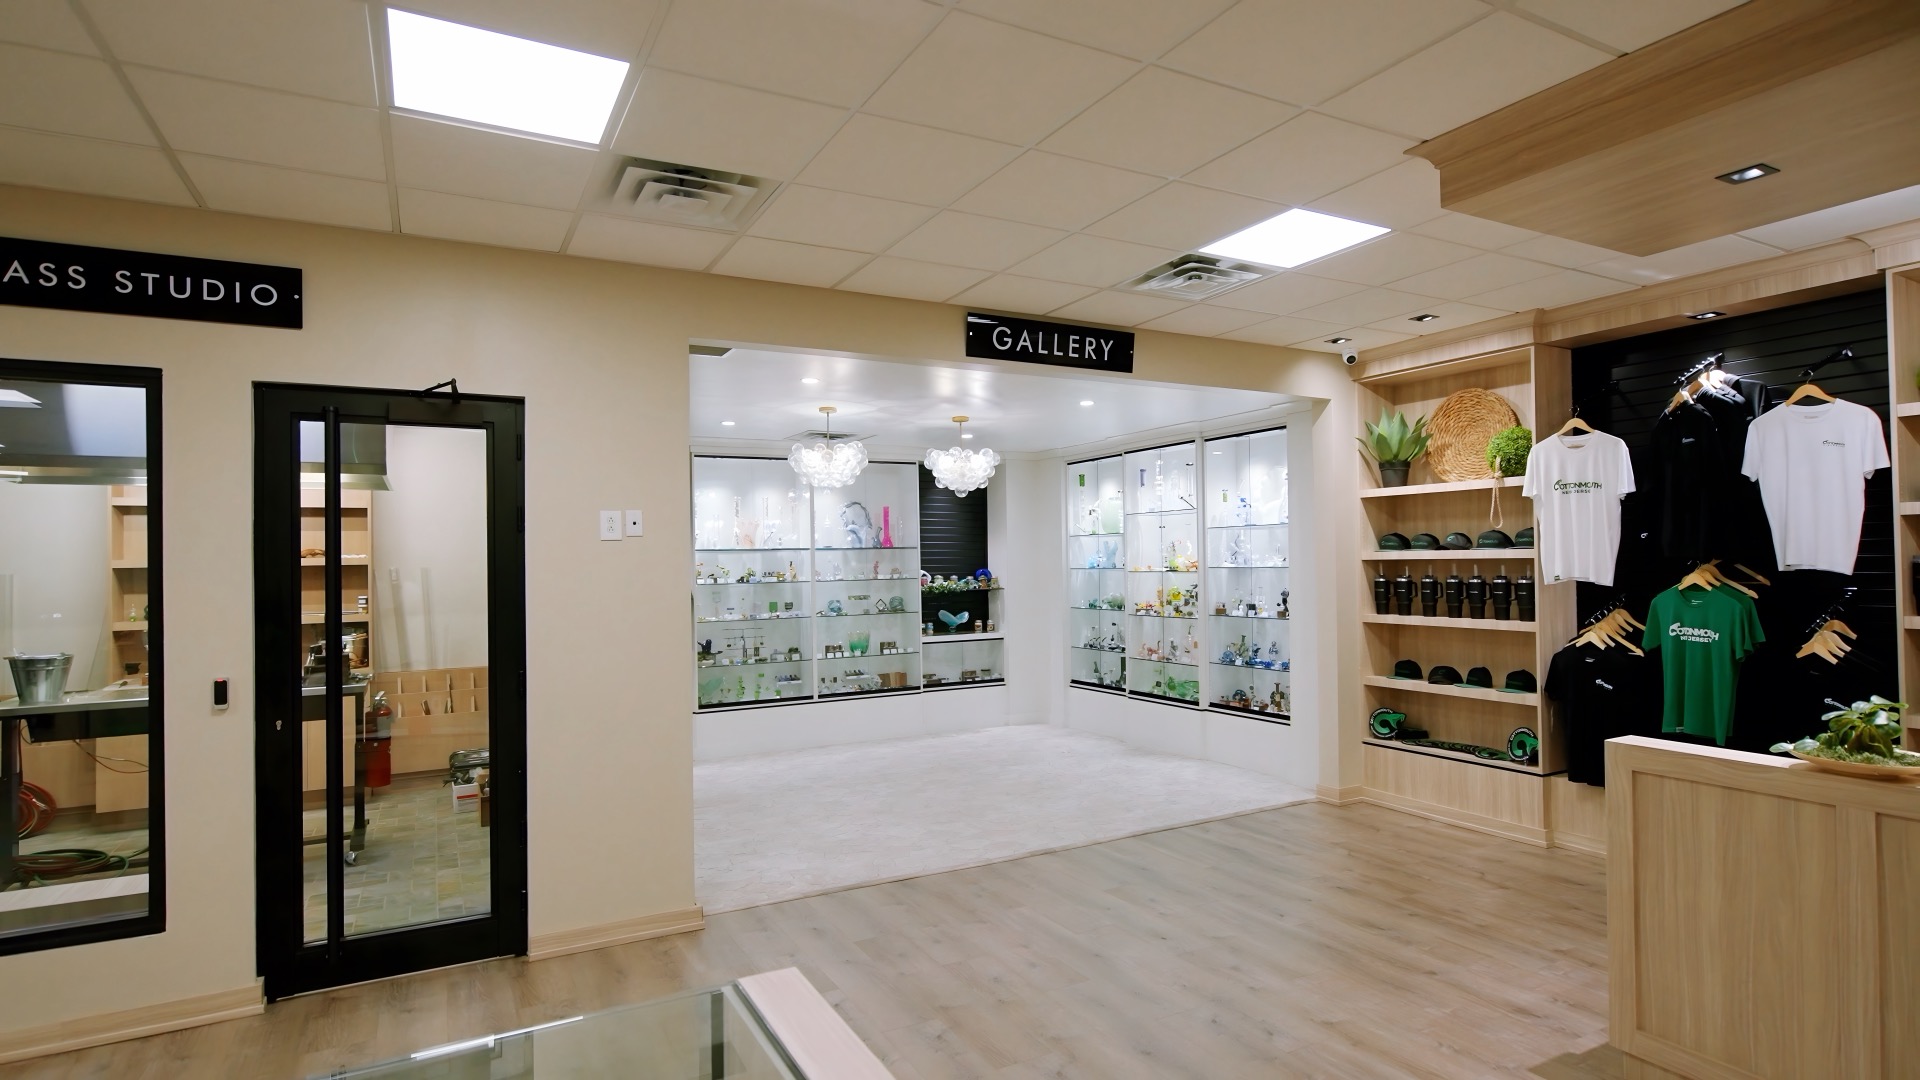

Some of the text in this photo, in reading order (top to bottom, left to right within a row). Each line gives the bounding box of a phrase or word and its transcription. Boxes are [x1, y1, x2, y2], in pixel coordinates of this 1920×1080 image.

[2, 259, 278, 306] ASS STUDIO
[992, 326, 1114, 361] GALLERY
[1668, 622, 1720, 641] COTONMOUH
